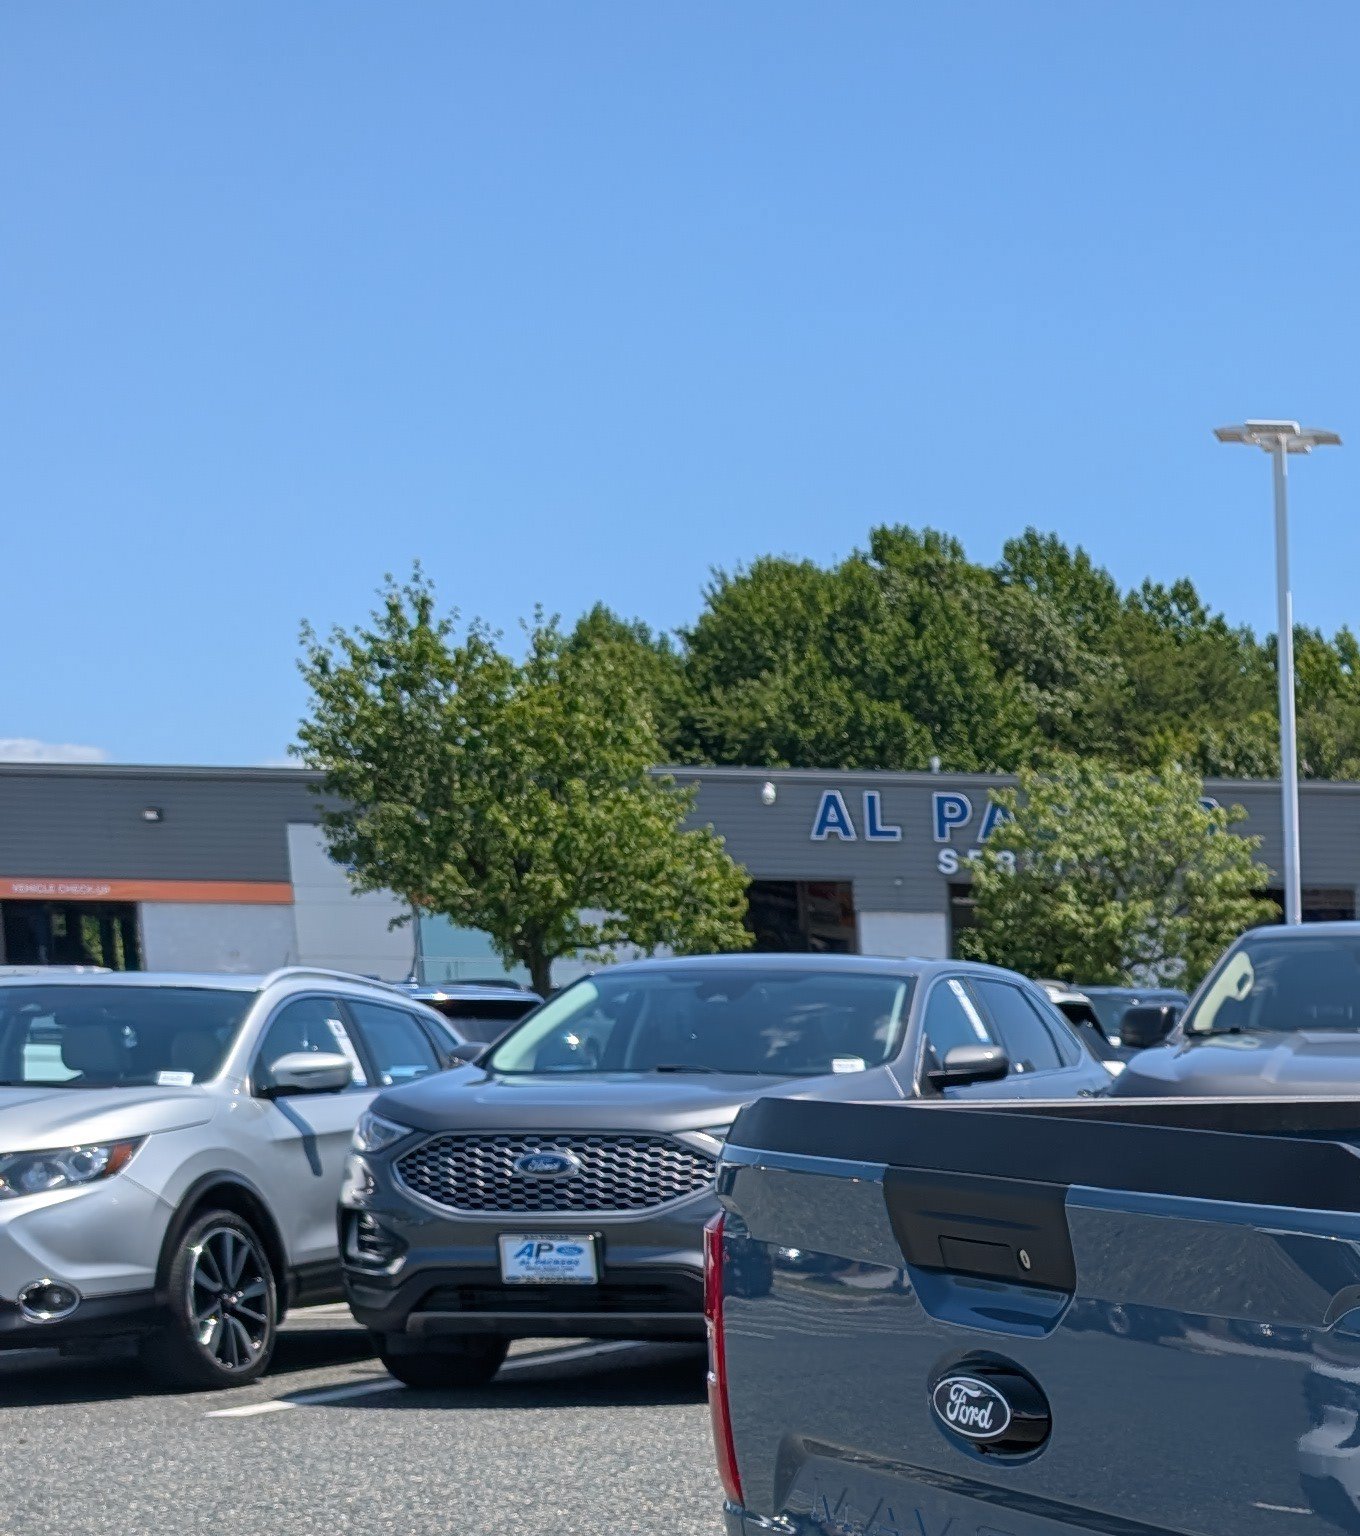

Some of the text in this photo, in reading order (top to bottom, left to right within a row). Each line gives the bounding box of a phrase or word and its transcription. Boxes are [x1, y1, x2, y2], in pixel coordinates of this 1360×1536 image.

[810, 789, 902, 842] AL
[514, 1243, 554, 1259] AP
[946, 1383, 994, 1429] Ford
